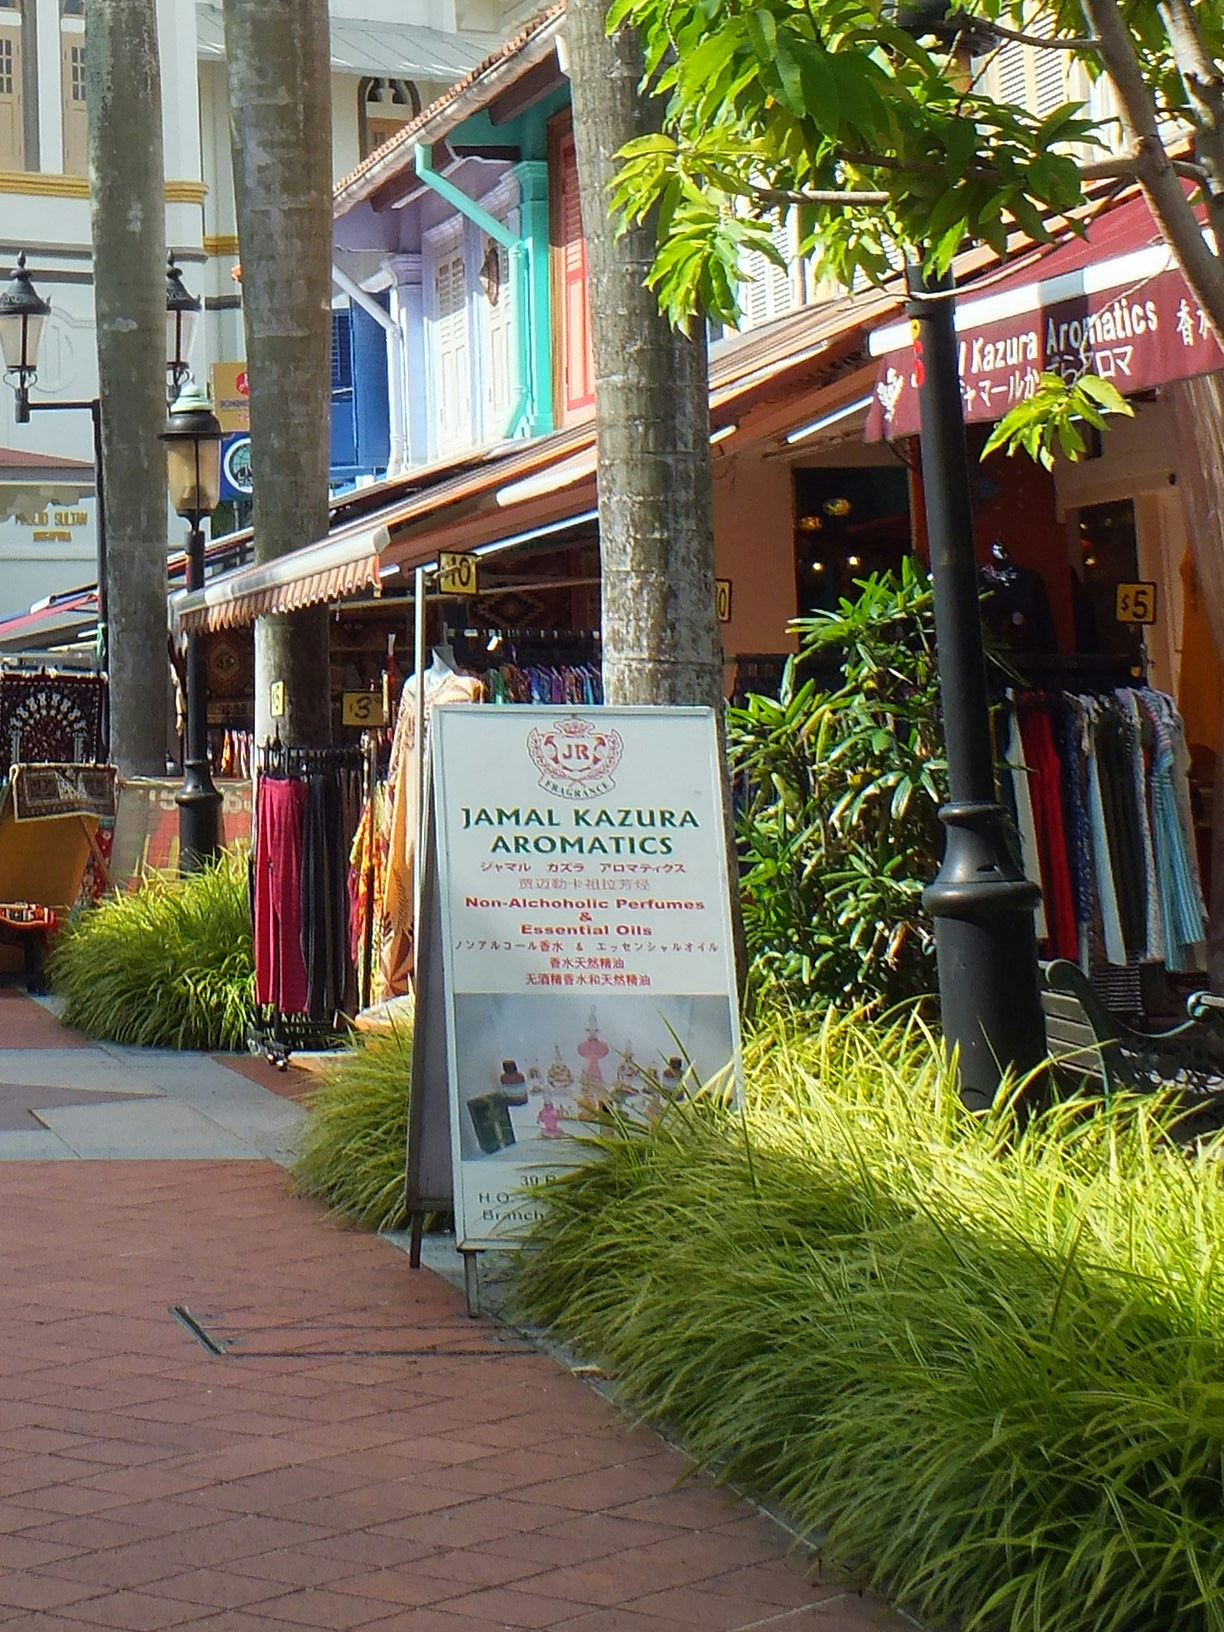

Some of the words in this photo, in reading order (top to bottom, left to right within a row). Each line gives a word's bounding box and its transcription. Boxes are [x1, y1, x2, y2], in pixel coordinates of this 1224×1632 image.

[971, 331, 1039, 374] Kazura
[1047, 297, 1159, 355] Aromatics
[1119, 589, 1148, 620] $5
[562, 744, 590, 760] JR
[461, 807, 561, 829] JAMAL
[574, 808, 700, 828] KAZURA
[490, 835, 673, 855] AROMATICS
[465, 897, 609, 910] Non-Alchoholic
[616, 898, 705, 911] Perfumes
[579, 911, 593, 922] &
[520, 924, 609, 936] Essential
[616, 925, 653, 936] Oils
